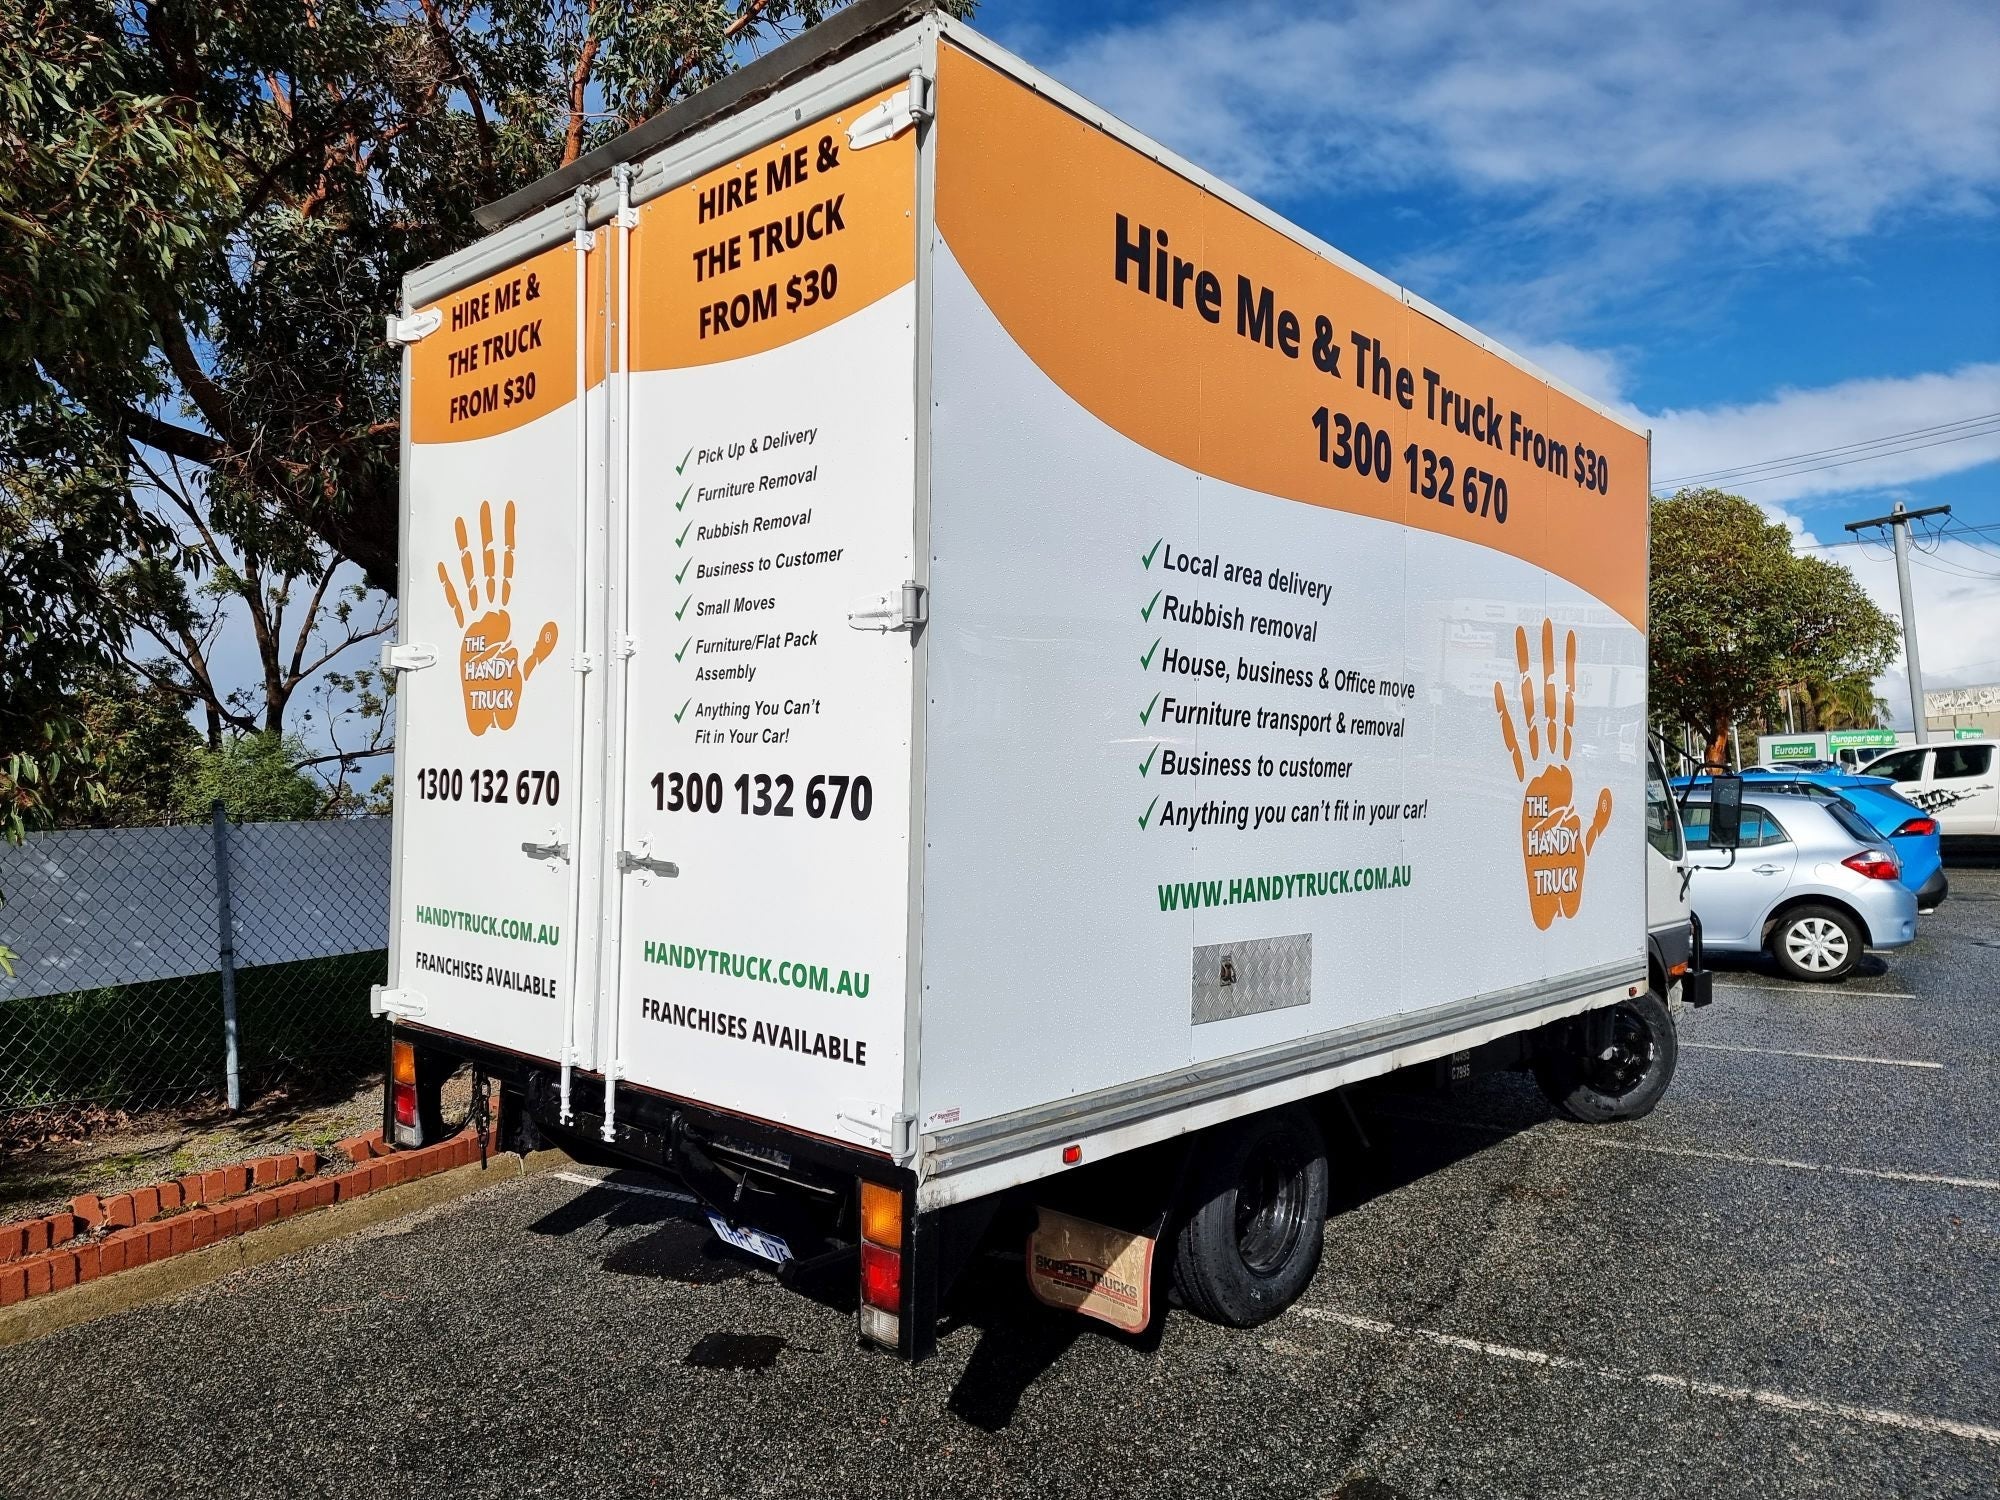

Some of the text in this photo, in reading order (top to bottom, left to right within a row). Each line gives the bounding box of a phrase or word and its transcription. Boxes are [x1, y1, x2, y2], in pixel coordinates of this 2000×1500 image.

[698, 136, 840, 225] HIRE ME &
[693, 194, 846, 282] THE TRUCK
[451, 273, 540, 333] HIRE ME &
[700, 264, 837, 339] FROM $30
[449, 319, 542, 378] THE TRUCK
[1115, 213, 1607, 495] Hire Me & The Truck From $30
[450, 372, 535, 423] FROM $30
[698, 428, 817, 464] Pick Up & Delivery
[1312, 406, 1507, 524] 1300 132 670
[698, 466, 817, 502] Furniture Removal
[698, 509, 811, 540] Rubbish Removal
[697, 549, 843, 578] Business to Customer
[1164, 544, 1332, 606] Local area delivery
[697, 598, 775, 616] Small Moves
[1163, 595, 1317, 642] Rubbish removal
[465, 636, 485, 652] THE
[696, 631, 817, 653] Furniture/Flat Pack
[464, 659, 516, 681] HANDY
[696, 664, 756, 682] Assembly
[1162, 648, 1414, 698] House, business & Office move
[470, 690, 514, 710] TRUCK
[696, 699, 820, 720] Anything You Can't
[1162, 698, 1404, 737] Furniture transport & removal
[696, 729, 789, 743] Fit in Your Car!
[1774, 746, 1812, 756] Europcar
[1831, 735, 1865, 745] Europcar
[1161, 750, 1352, 778] Business to customer
[418, 768, 559, 806] 1300 132 670
[651, 772, 872, 820] 1300 132 670
[1160, 800, 1427, 832] Anything you can't fit in your car!
[1526, 796, 1548, 818] THE
[1528, 828, 1578, 857] HANDY
[1158, 866, 1410, 911] WWW.HANDYTRUCK.COM.AU
[1534, 867, 1578, 896] TRUCK
[416, 904, 559, 947] HANDYTRUCK.COM.AU
[417, 952, 556, 998] FRANCHISES AVAILABLE
[644, 941, 871, 1000] HANDYTRUCK.COM.AU
[643, 998, 866, 1065] FRANCHISES AVAILABLE
[1035, 1255, 1087, 1280] SKIPPER
[1089, 1269, 1138, 1299] TRUCKS
